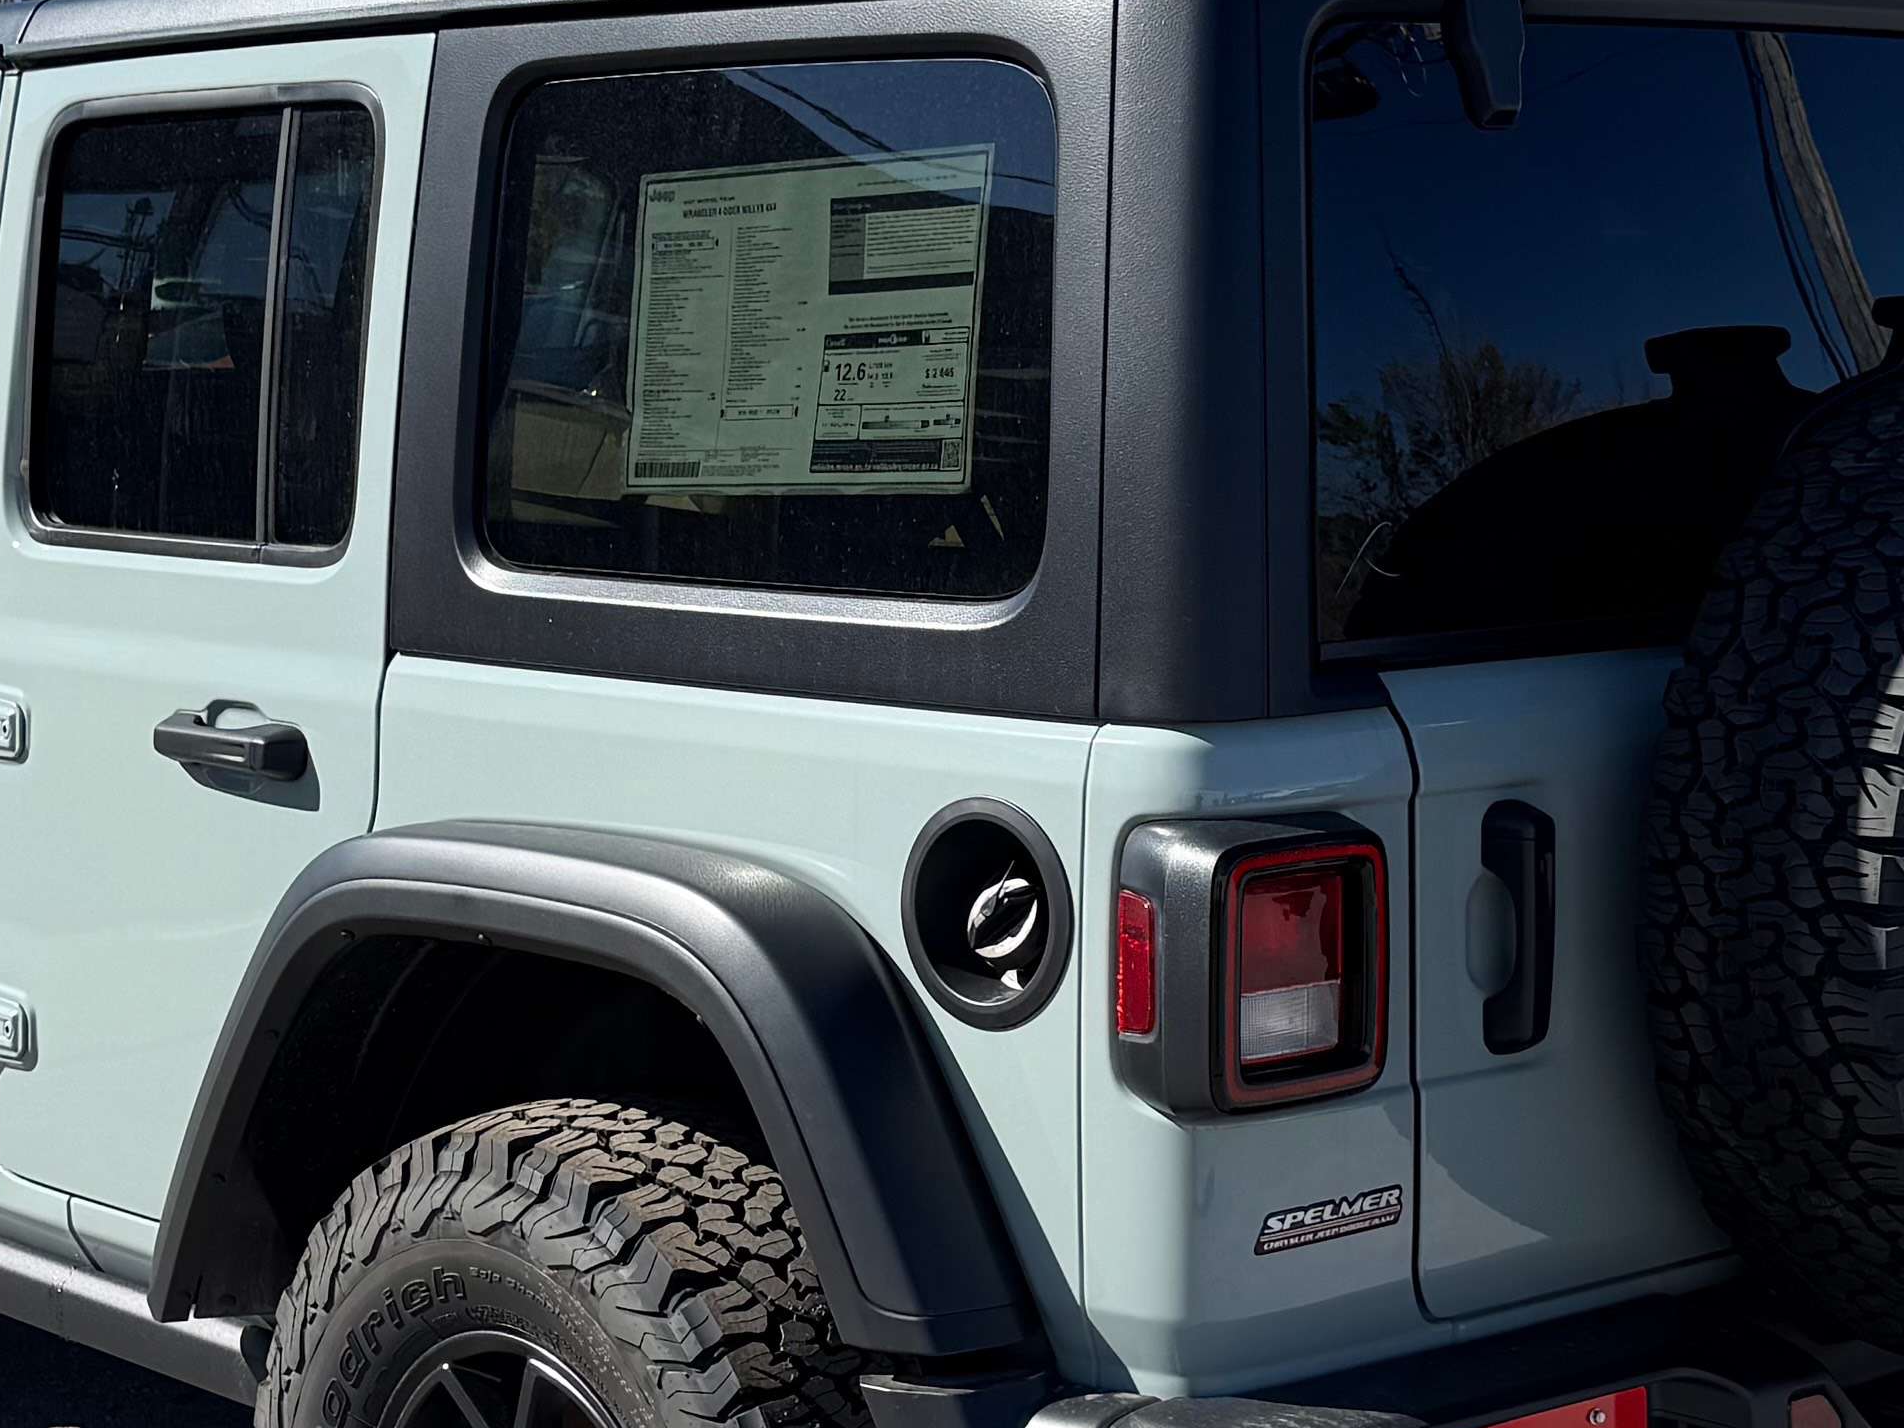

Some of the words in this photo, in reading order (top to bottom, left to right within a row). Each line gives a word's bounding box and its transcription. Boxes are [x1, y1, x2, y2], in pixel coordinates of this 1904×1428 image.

[835, 363, 866, 381] 12.6
[834, 389, 846, 401] 22
[1264, 1189, 1400, 1233] SPELMER
[1264, 1234, 1314, 1251] CHRYSLER
[1315, 1227, 1339, 1240] JEEP
[1371, 1214, 1396, 1227] RAM
